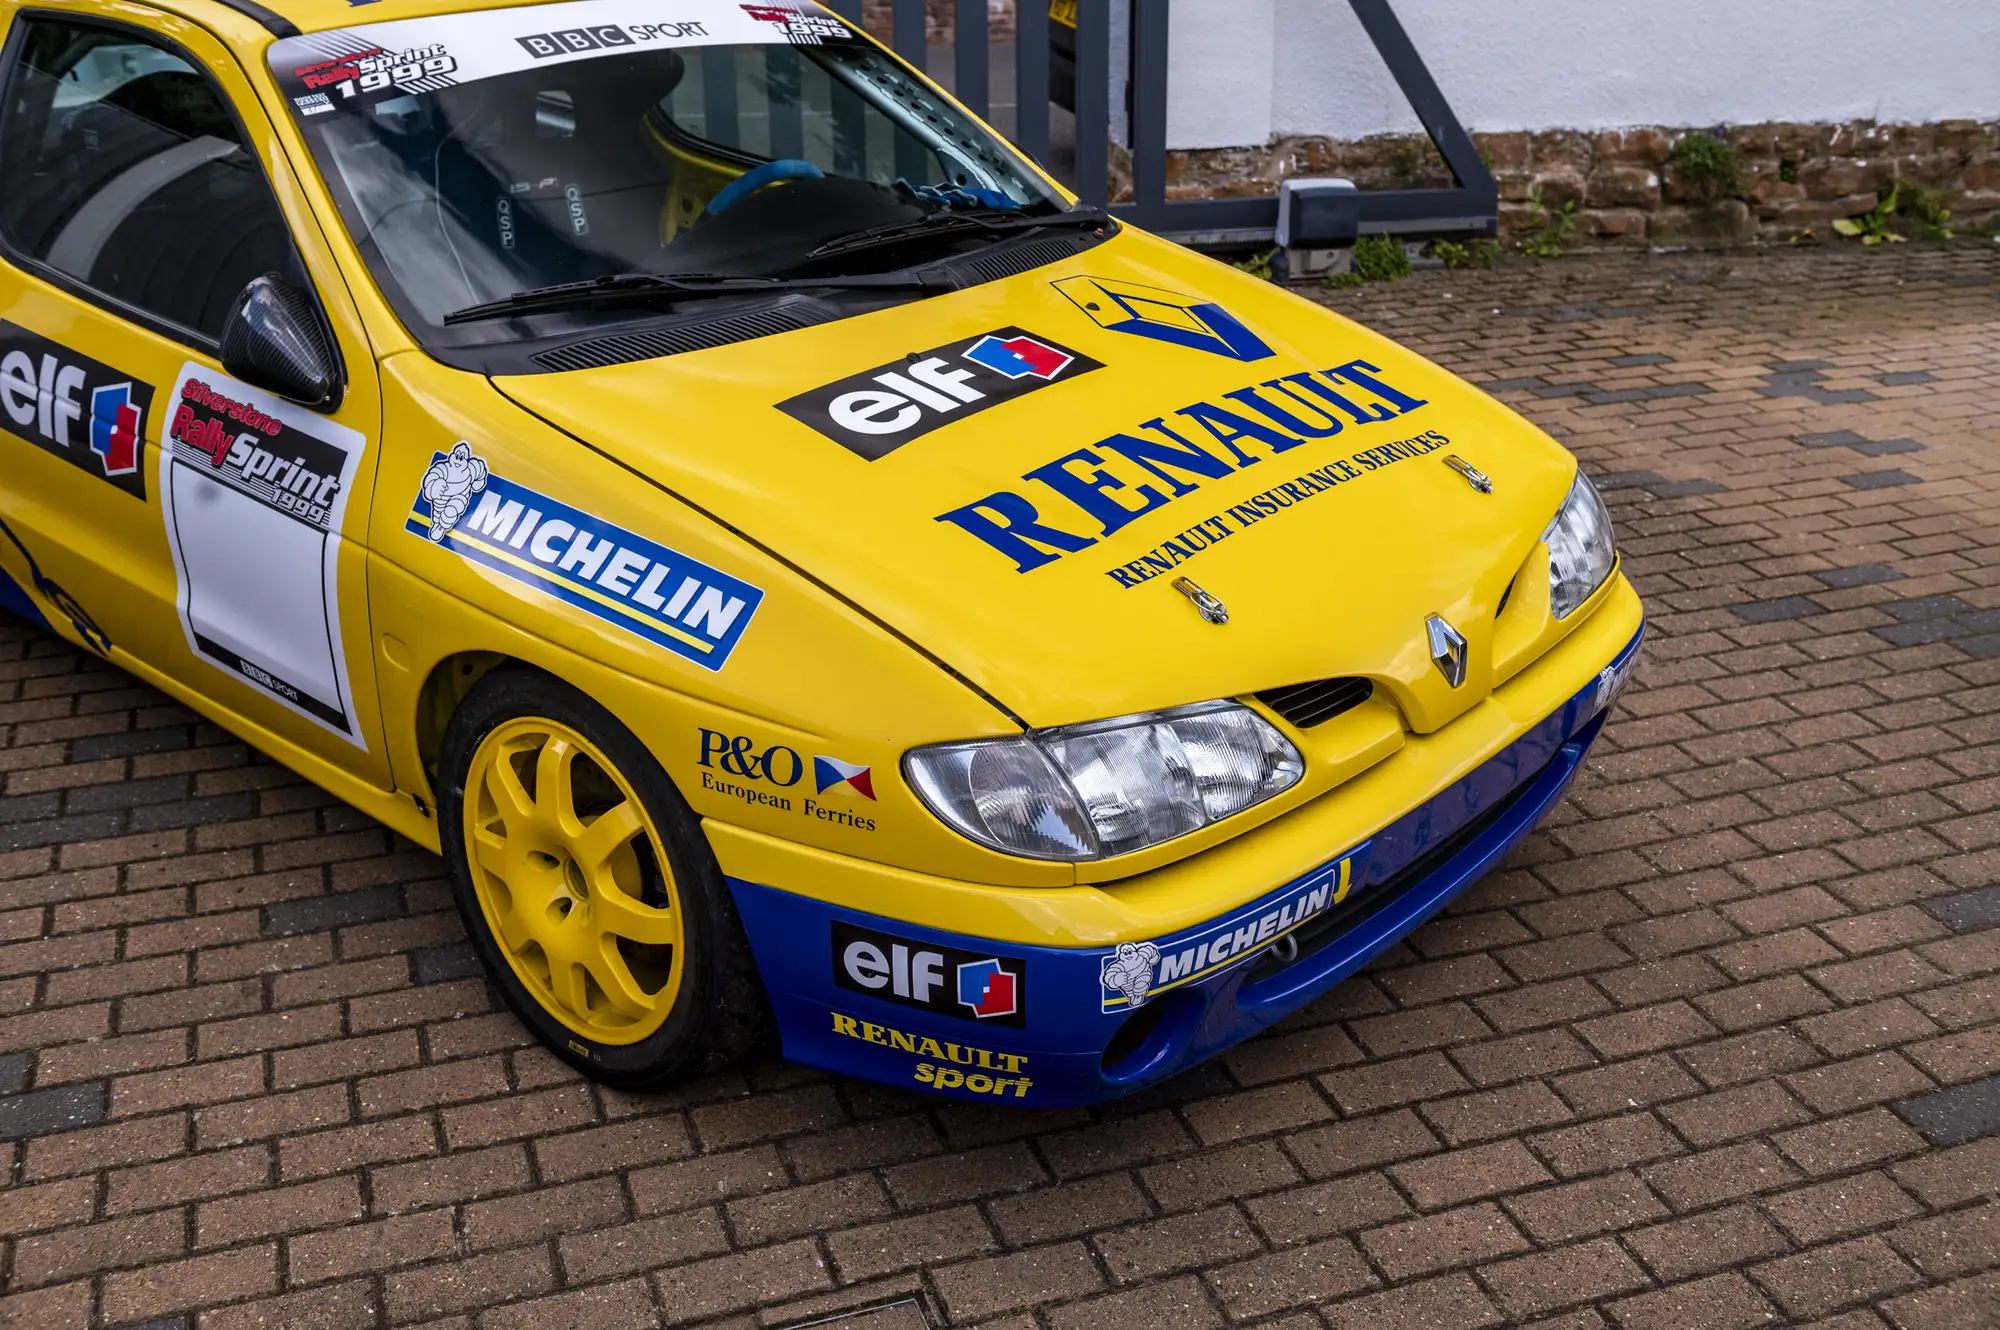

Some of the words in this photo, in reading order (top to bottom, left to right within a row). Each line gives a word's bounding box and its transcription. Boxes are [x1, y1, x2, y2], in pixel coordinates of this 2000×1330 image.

[518, 25, 632, 58] BBC
[628, 21, 709, 41] SPORT
[773, 22, 853, 39] 1999
[336, 55, 457, 99] 1999
[498, 199, 513, 246] QSP
[565, 186, 586, 233] QSP
[0, 350, 86, 447] elf
[181, 378, 282, 436] Silverstone
[829, 356, 986, 435] elf
[933, 359, 1429, 574] RENAULT
[269, 487, 326, 526] 1999
[1105, 515, 1235, 589] RENAULT
[1224, 459, 1363, 528] INSURANCE
[1352, 430, 1450, 471] SERVICES
[466, 490, 746, 640] MICHELIN
[240, 660, 273, 688] BBC
[697, 727, 803, 787] P&O
[701, 771, 791, 811] European
[803, 799, 876, 832] Ferries
[1159, 883, 1330, 984] MICHELIN
[843, 941, 944, 1003] elf
[830, 1012, 1028, 1074] RENAULT
[914, 1063, 1033, 1098] sport
